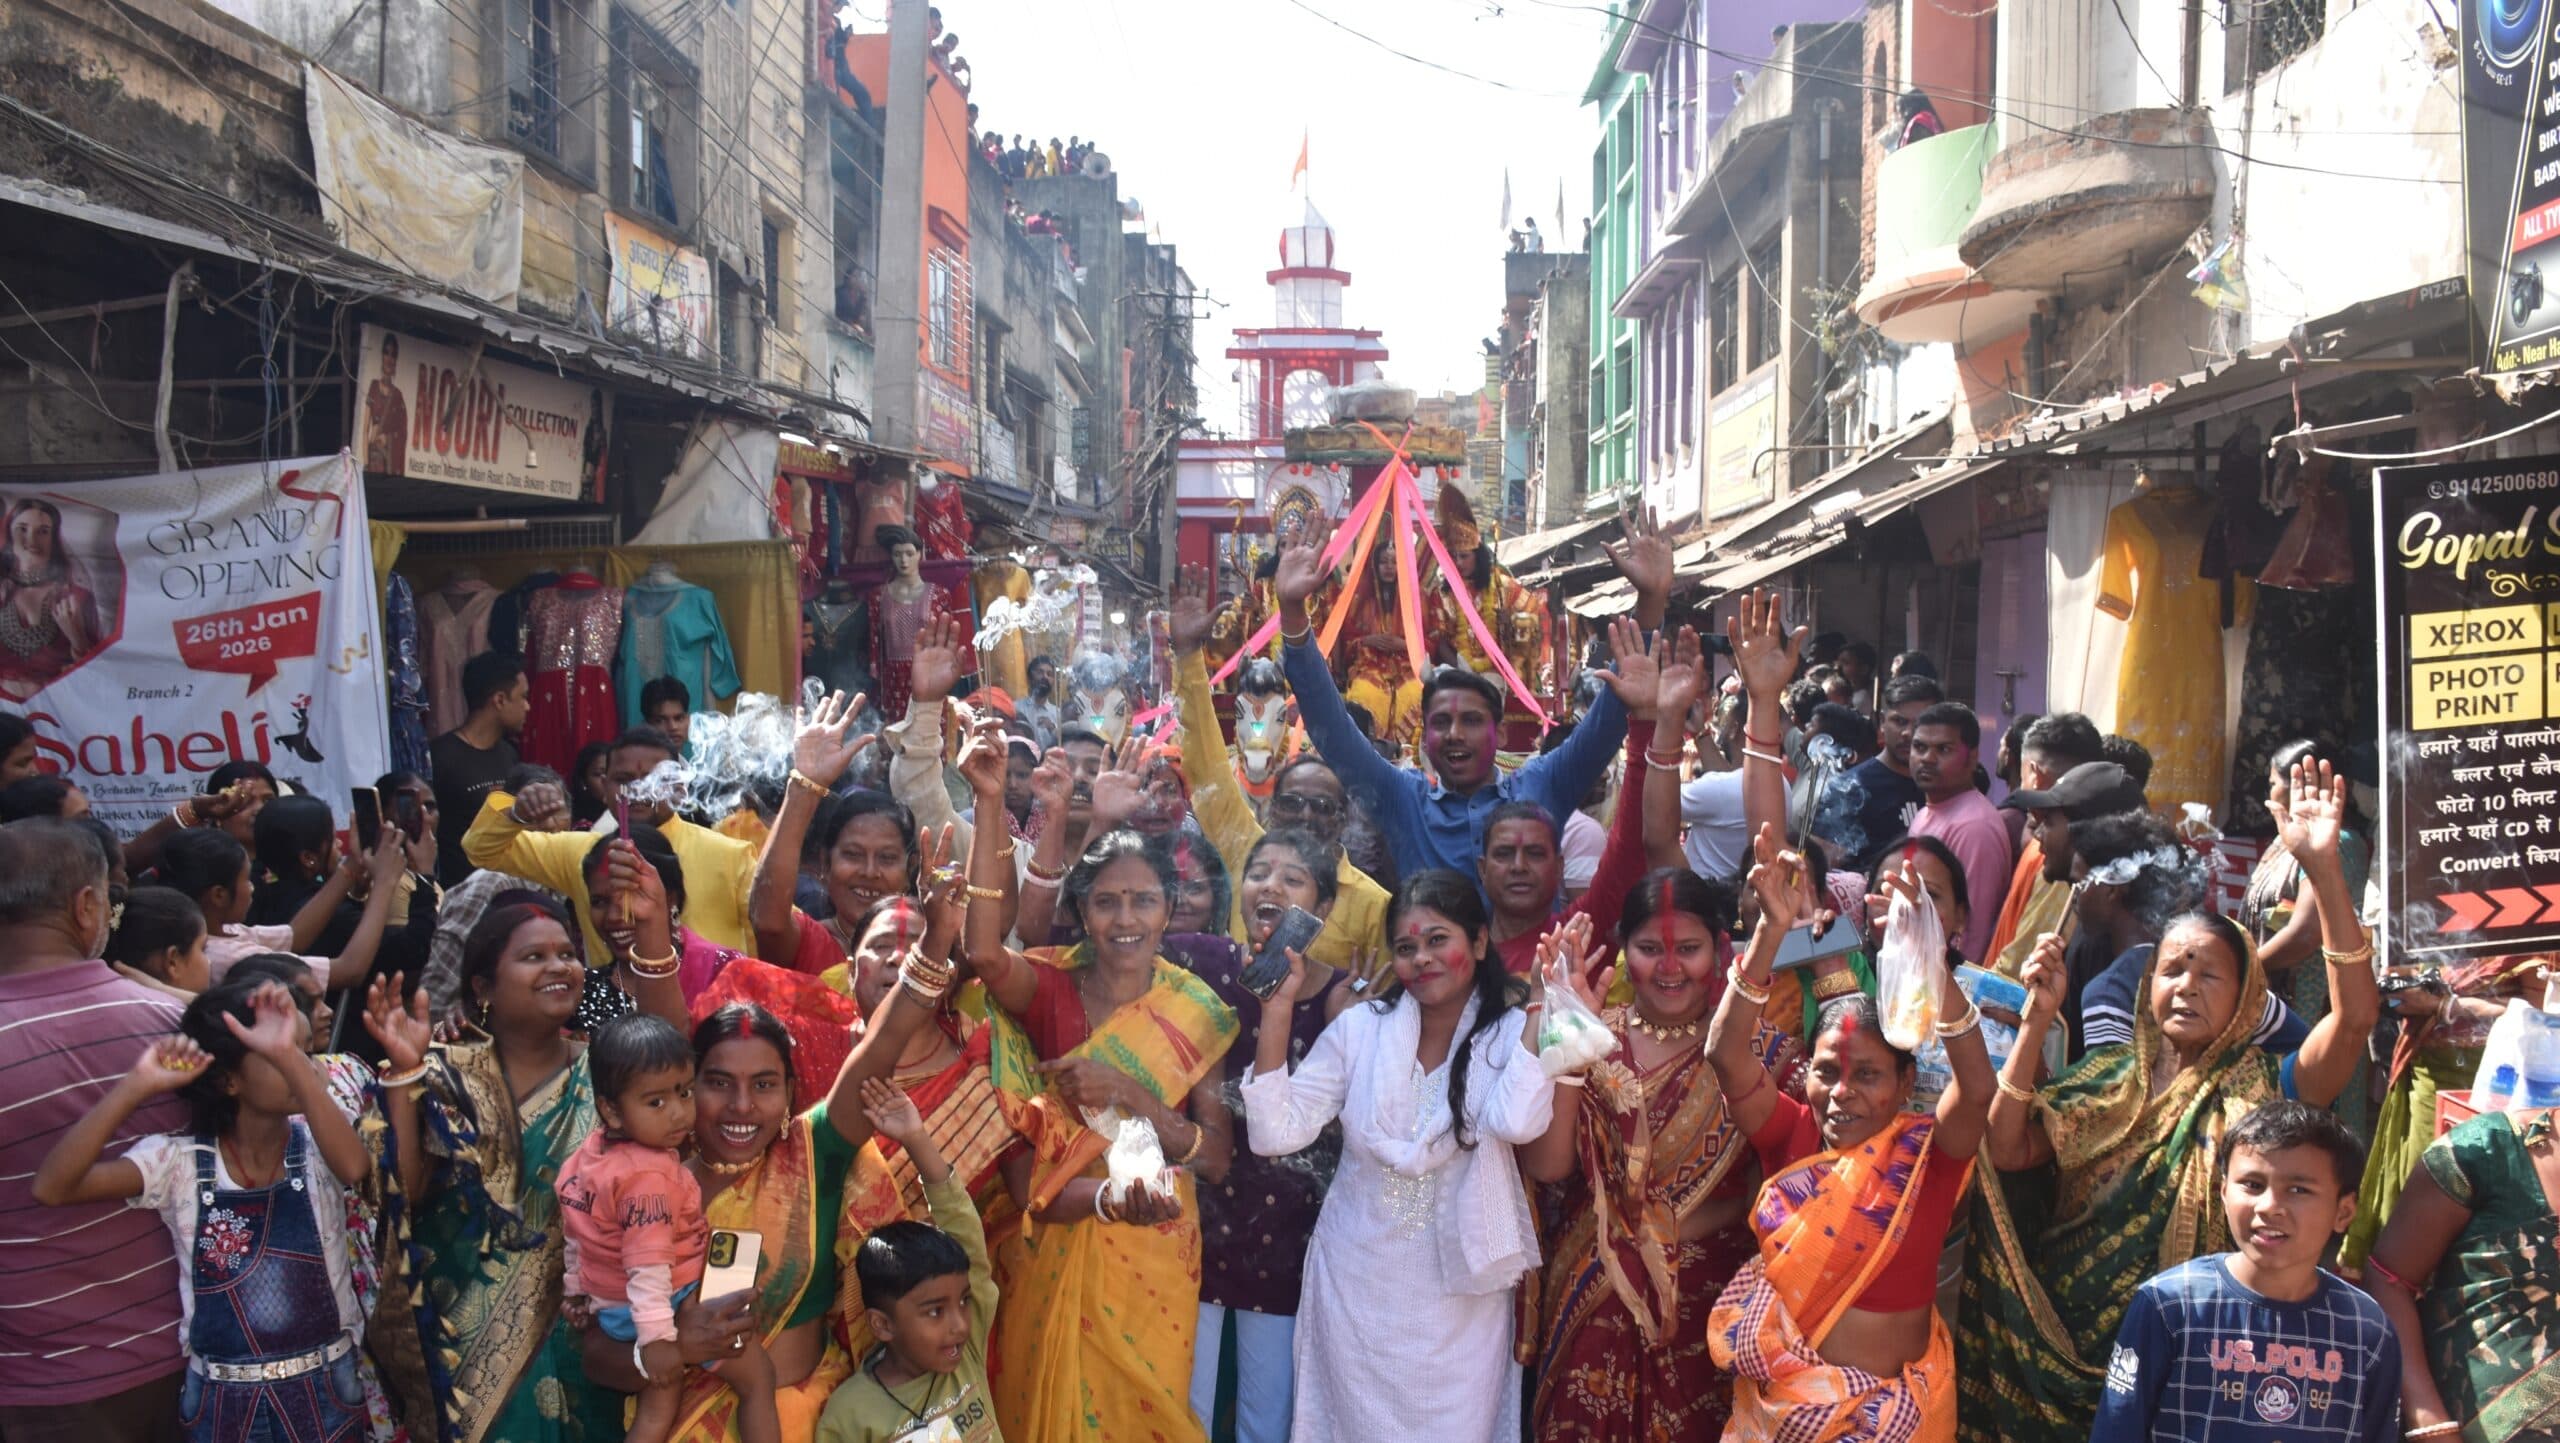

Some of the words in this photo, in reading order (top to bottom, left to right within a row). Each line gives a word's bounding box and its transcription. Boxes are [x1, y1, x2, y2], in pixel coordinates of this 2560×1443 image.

[2523, 212, 2543, 241] ALL
[2420, 279, 2462, 303] PIZZA
[2522, 344, 2547, 366] Near
[504, 403, 579, 440] COLLECTION
[2448, 470, 2559, 498] 9142500680
[147, 507, 306, 557] GRAND
[2398, 505, 2539, 581] Gopal
[160, 544, 341, 601] OPENING
[186, 617, 244, 646] 26th
[251, 604, 309, 633] Jan
[2429, 616, 2526, 648] XEROX
[219, 635, 272, 660] 2026
[126, 685, 180, 701] Branch
[184, 684, 194, 698] 2
[2429, 663, 2525, 693] PHOTO
[26, 710, 272, 778] Saheli
[2418, 735, 2462, 758] हमारे
[2466, 728, 2499, 753] यहाँ
[2452, 766, 2495, 784] कलर
[2498, 758, 2526, 783] एवं
[2436, 792, 2476, 815] फोटो
[2481, 794, 2507, 812] 10
[2511, 787, 2558, 809] मिनट
[2418, 822, 2462, 847] हमारे
[2466, 816, 2499, 841] यहाँ
[2504, 821, 2530, 838] CD
[2535, 813, 2552, 835] से
[2439, 851, 2521, 875] Convert
